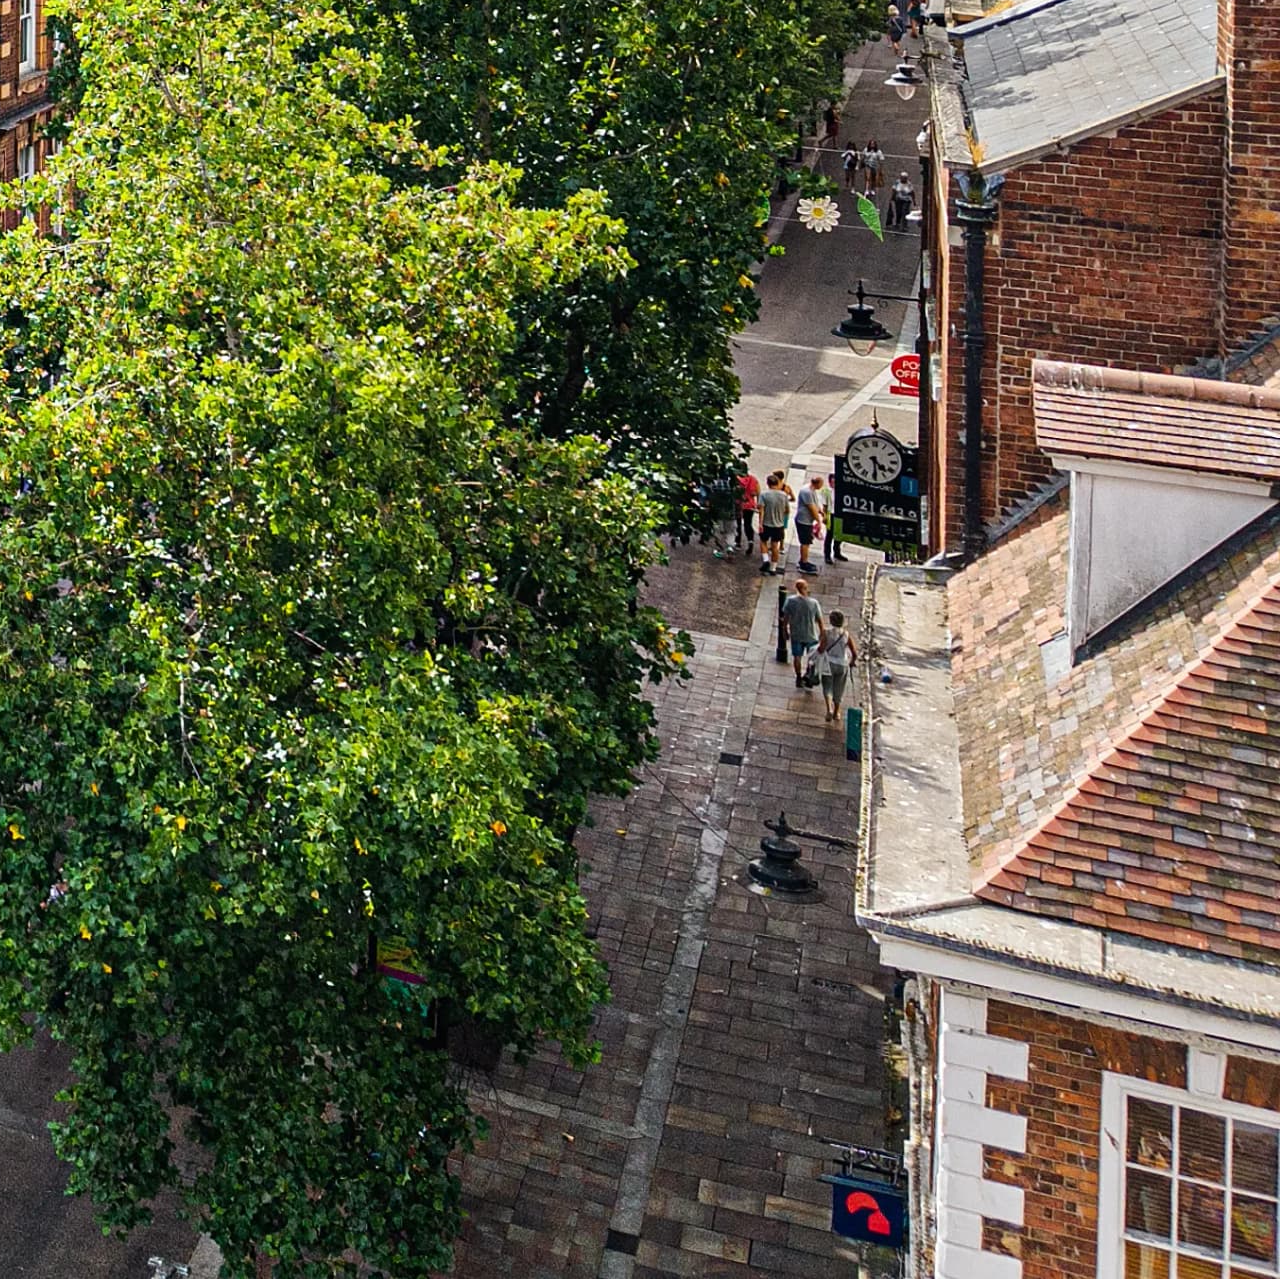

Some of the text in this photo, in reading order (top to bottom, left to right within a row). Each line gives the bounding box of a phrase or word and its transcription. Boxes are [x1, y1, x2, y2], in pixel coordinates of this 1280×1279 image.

[902, 360, 920, 370] PO
[895, 369, 920, 380] OFFI
[843, 495, 874, 515] 0121
